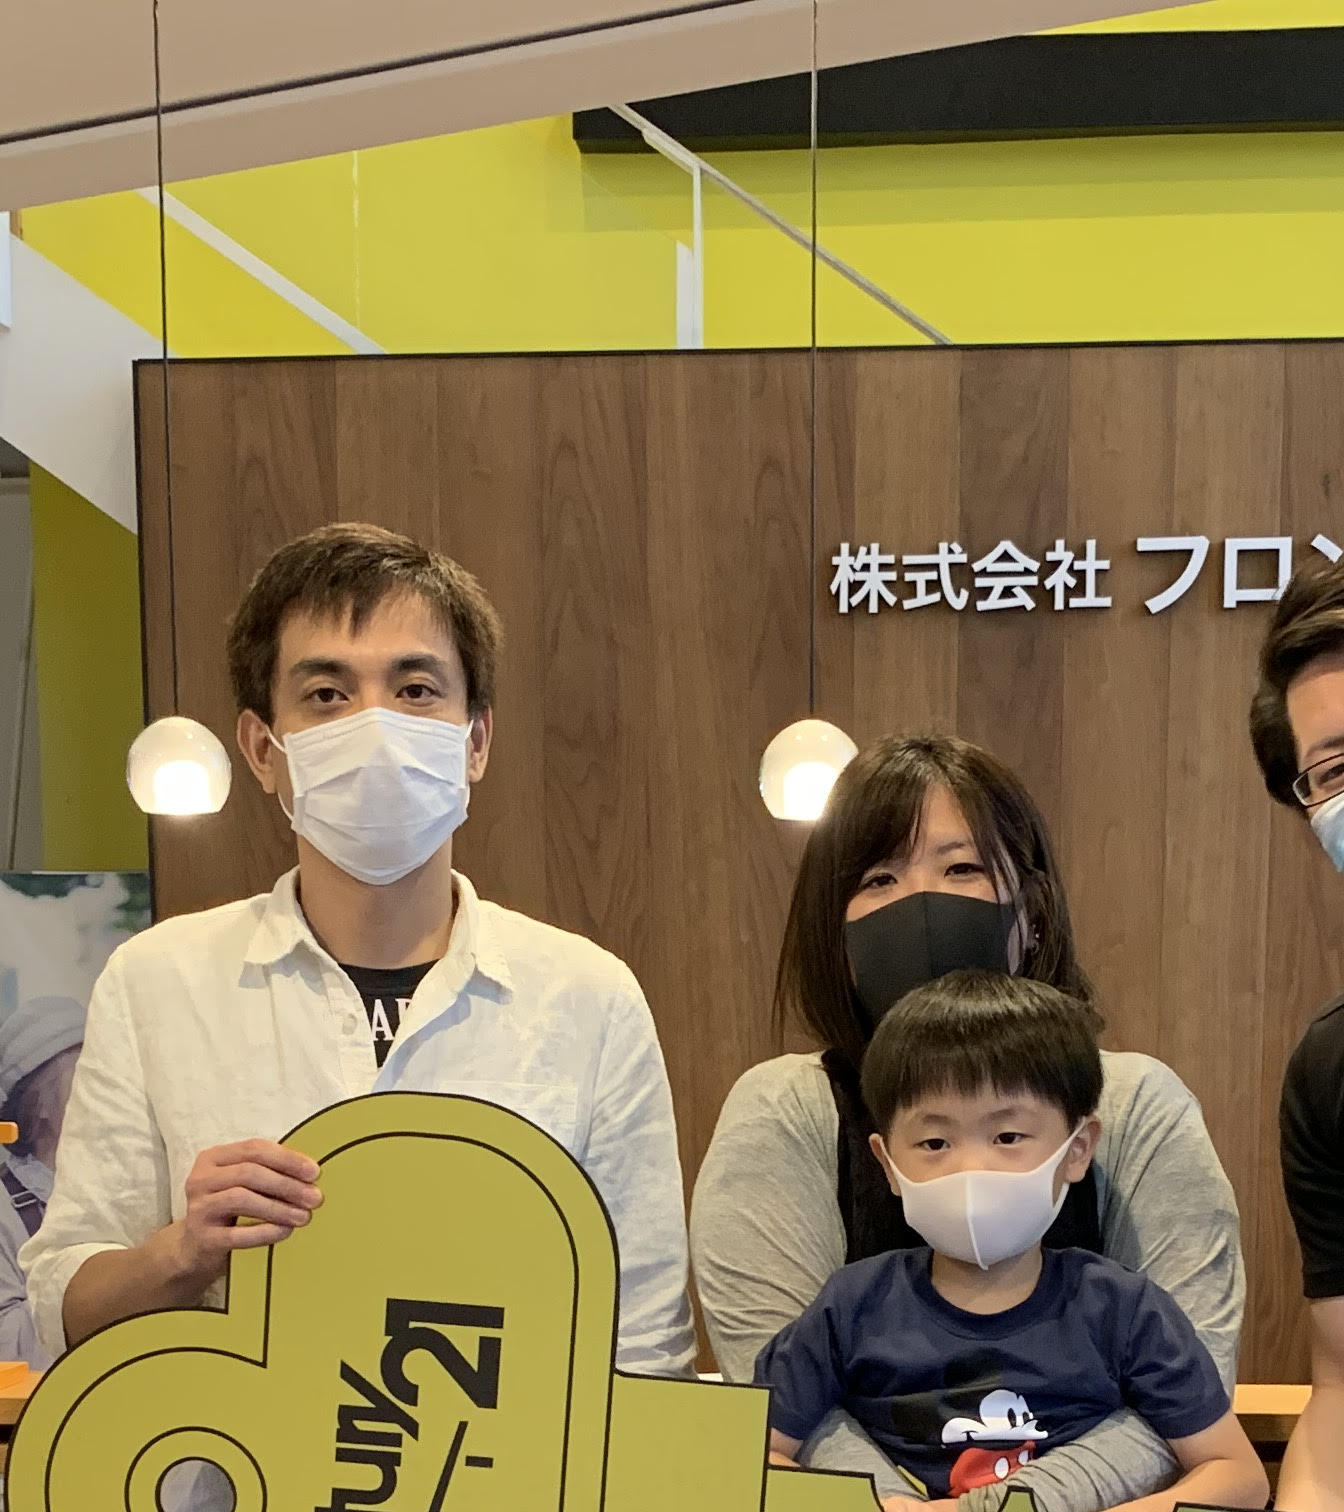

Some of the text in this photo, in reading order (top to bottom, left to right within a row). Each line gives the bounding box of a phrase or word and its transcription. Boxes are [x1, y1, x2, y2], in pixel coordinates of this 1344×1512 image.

[830, 539, 1112, 614] 株式会社
[379, 1297, 505, 1410] 21
